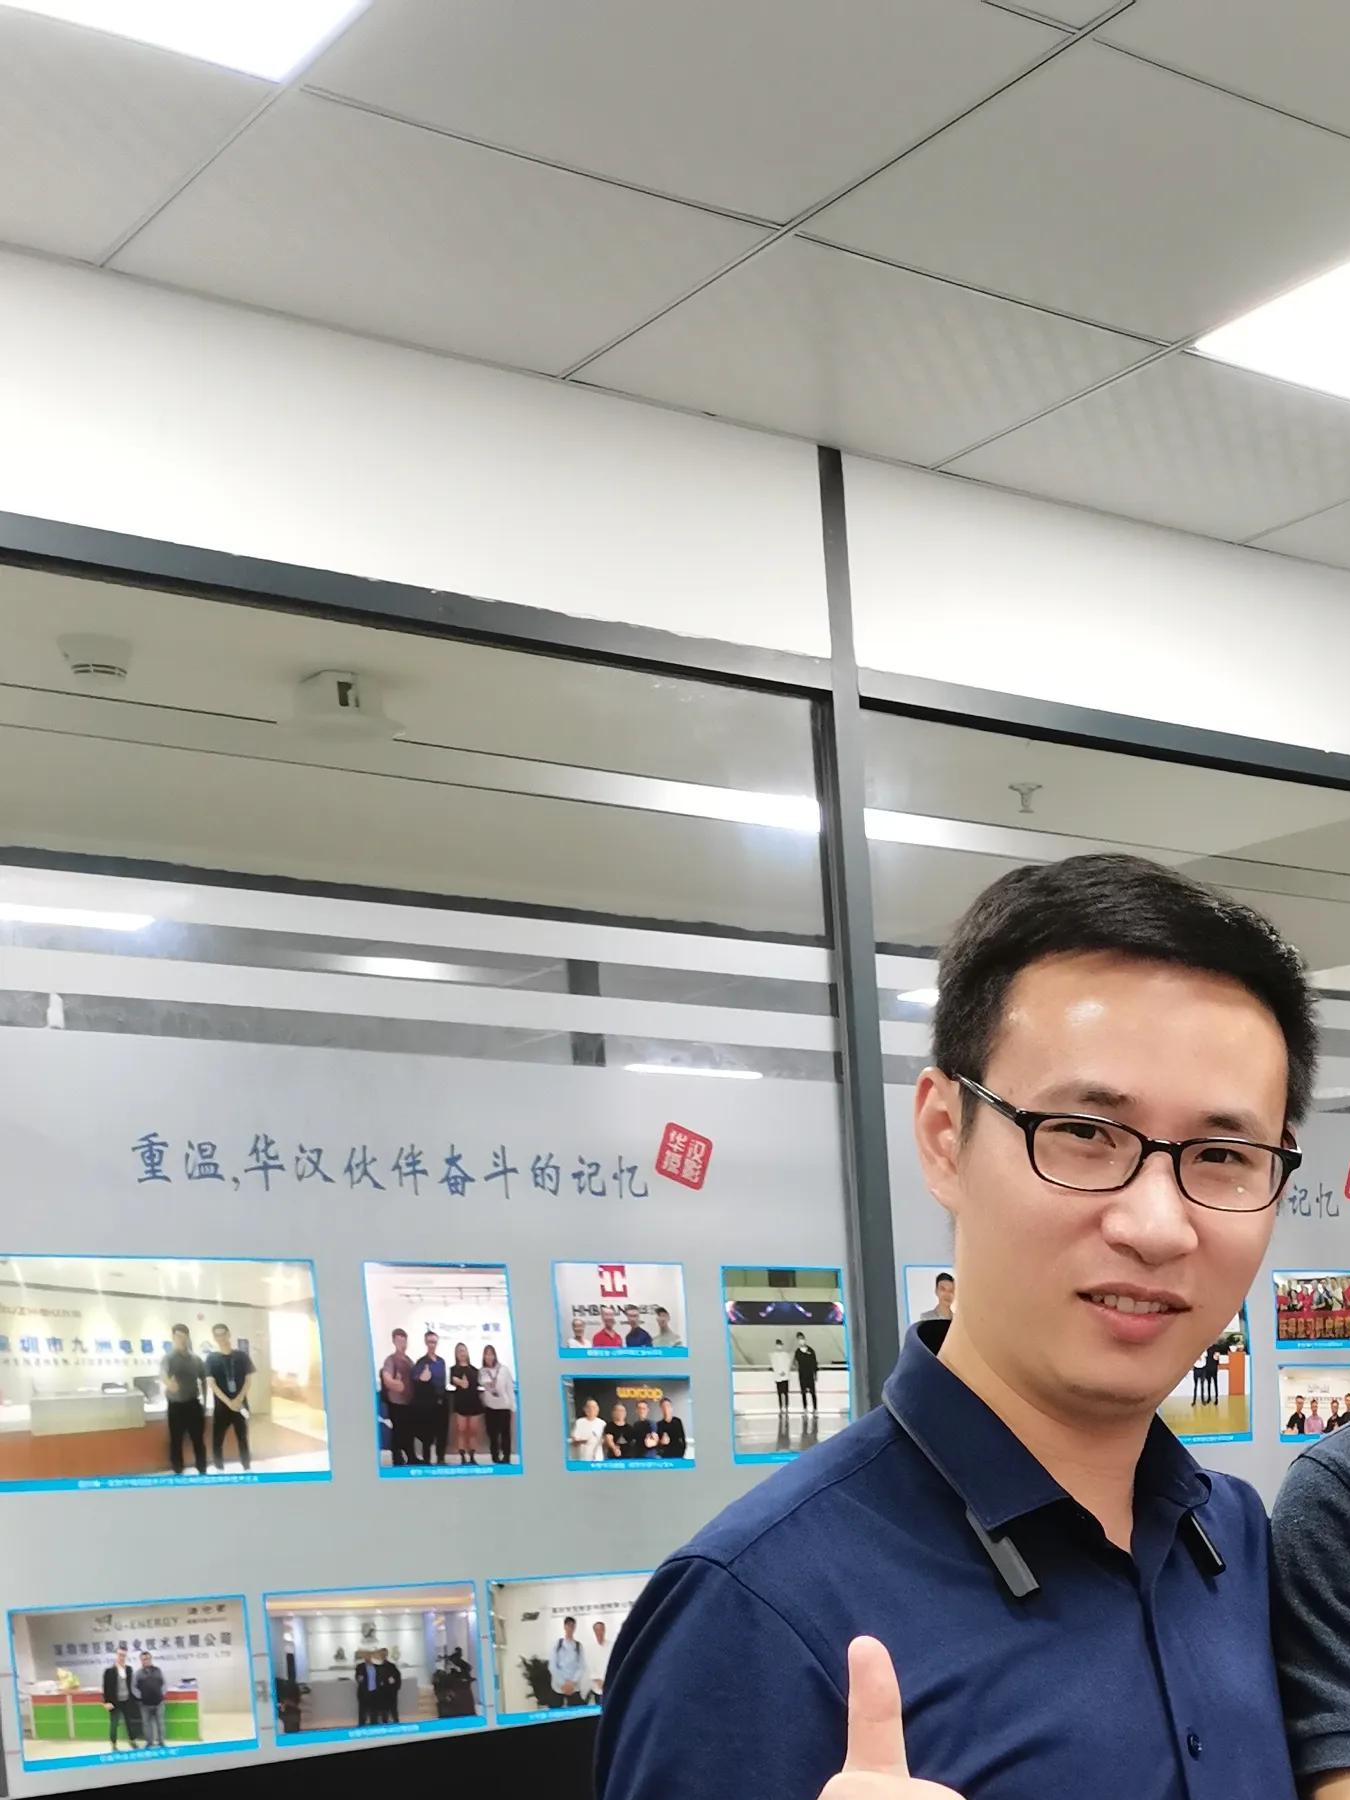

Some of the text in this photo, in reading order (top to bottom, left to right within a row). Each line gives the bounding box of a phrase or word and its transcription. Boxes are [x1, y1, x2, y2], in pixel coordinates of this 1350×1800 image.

[131, 1132, 649, 1199] 重温,华汉伙伴奋斗的记忆
[1276, 1183, 1340, 1219] 记忆
